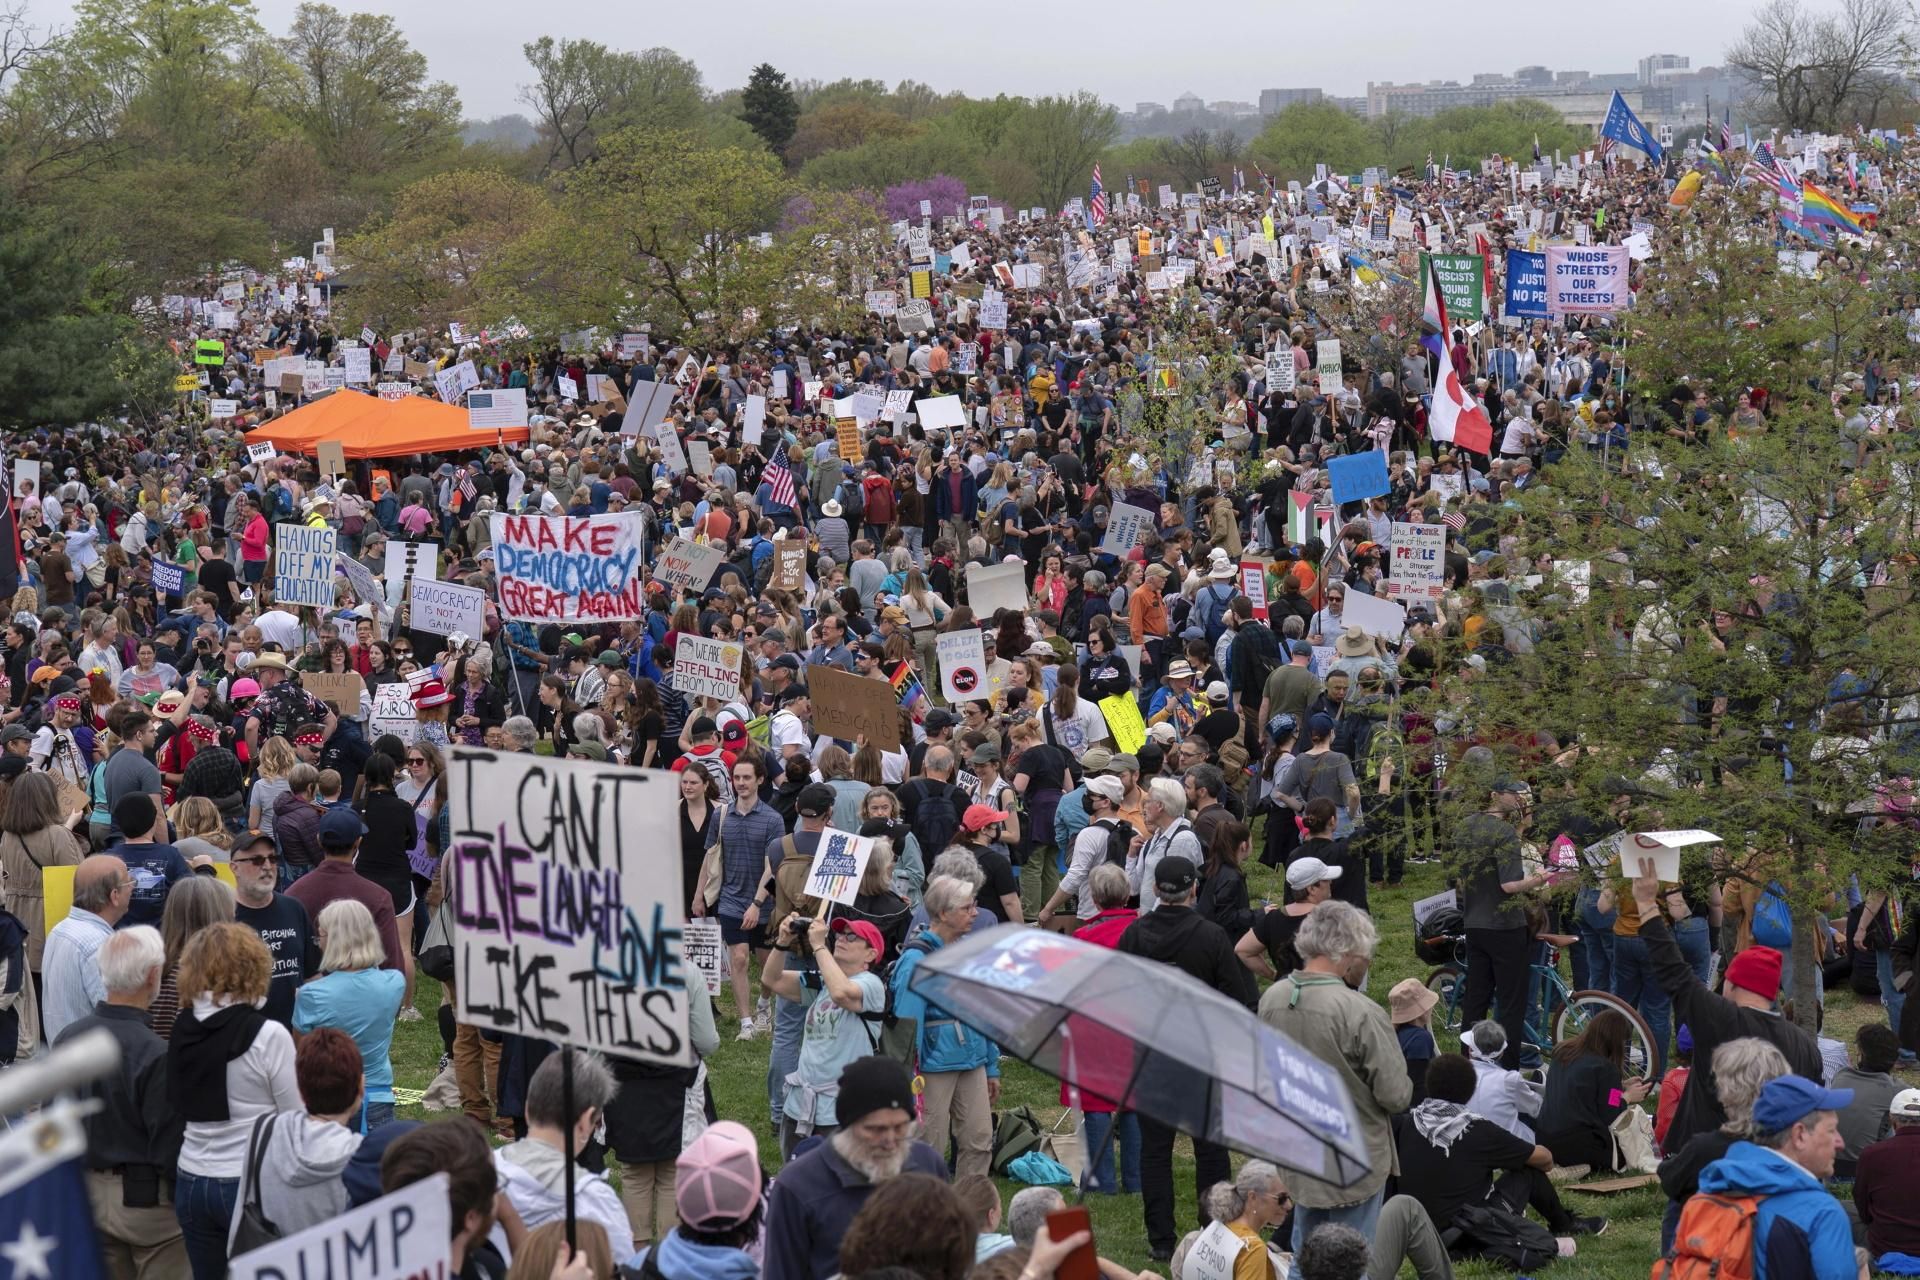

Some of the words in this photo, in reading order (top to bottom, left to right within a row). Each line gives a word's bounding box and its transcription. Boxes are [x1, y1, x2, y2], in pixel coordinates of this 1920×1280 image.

[909, 229, 924, 240] NC
[1566, 251, 1608, 262] WHOSE
[1455, 260, 1472, 270] YOU
[1556, 265, 1617, 276] STREETS?
[1438, 272, 1475, 282] ASCISTS
[1518, 274, 1546, 285] JUSTI
[1572, 279, 1596, 289] OUR
[1512, 289, 1530, 302] NO
[1558, 293, 1614, 304] STREETS!
[252, 447, 271, 456] OFF!
[1109, 520, 1118, 533] THE
[1116, 515, 1129, 543] WHOLE
[1124, 522, 1137, 549] WORLD
[1133, 514, 1140, 522] IS
[278, 526, 334, 554] HANDS
[503, 516, 619, 556] MAKE
[672, 540, 685, 552] IF
[687, 544, 711, 561] NOT
[781, 549, 805, 561] HANDS
[1397, 546, 1436, 560] PEOPLE
[153, 561, 182, 577] FREEDOM
[279, 551, 305, 576] OFF
[311, 555, 333, 580] MY
[497, 543, 637, 596] DEMOCRACY
[663, 556, 692, 571] NOW
[783, 560, 797, 570] OFF
[152, 575, 180, 591] FREEDOM
[153, 569, 181, 584] FREEDOM
[665, 569, 703, 588] WHEN?
[275, 575, 336, 607] EDUCATION
[500, 575, 570, 619] GREAT
[576, 577, 641, 619] AGAIN
[1404, 585, 1424, 594] Power
[412, 585, 480, 611] DEMOCRACY
[424, 604, 433, 615] IS
[436, 608, 454, 618] NOT
[456, 611, 463, 620] A
[428, 618, 457, 631] GAME
[939, 635, 980, 650] DELETE
[695, 642, 706, 660] WE
[706, 646, 722, 664] ARE
[944, 650, 980, 662] DOGE
[675, 659, 739, 684] STEALING
[310, 674, 349, 688] SILENCE
[675, 673, 705, 692] FROM
[710, 681, 736, 700] YOU
[956, 676, 975, 684] ELON
[387, 684, 402, 697] So
[379, 700, 417, 716] WRON
[816, 704, 892, 740] MEDICAID
[452, 750, 498, 843] I
[818, 865, 856, 874] EVERYONE
[823, 859, 855, 867] MEANS
[453, 820, 543, 944] LIVE
[538, 860, 625, 950] LAUGH
[591, 901, 686, 992] LOVE
[262, 927, 297, 941] BITCHING
[463, 941, 570, 1035] LIKE
[568, 970, 682, 1057] THIS
[255, 1204, 415, 1280] UMP
[1196, 1240, 1226, 1273] DEMAND
